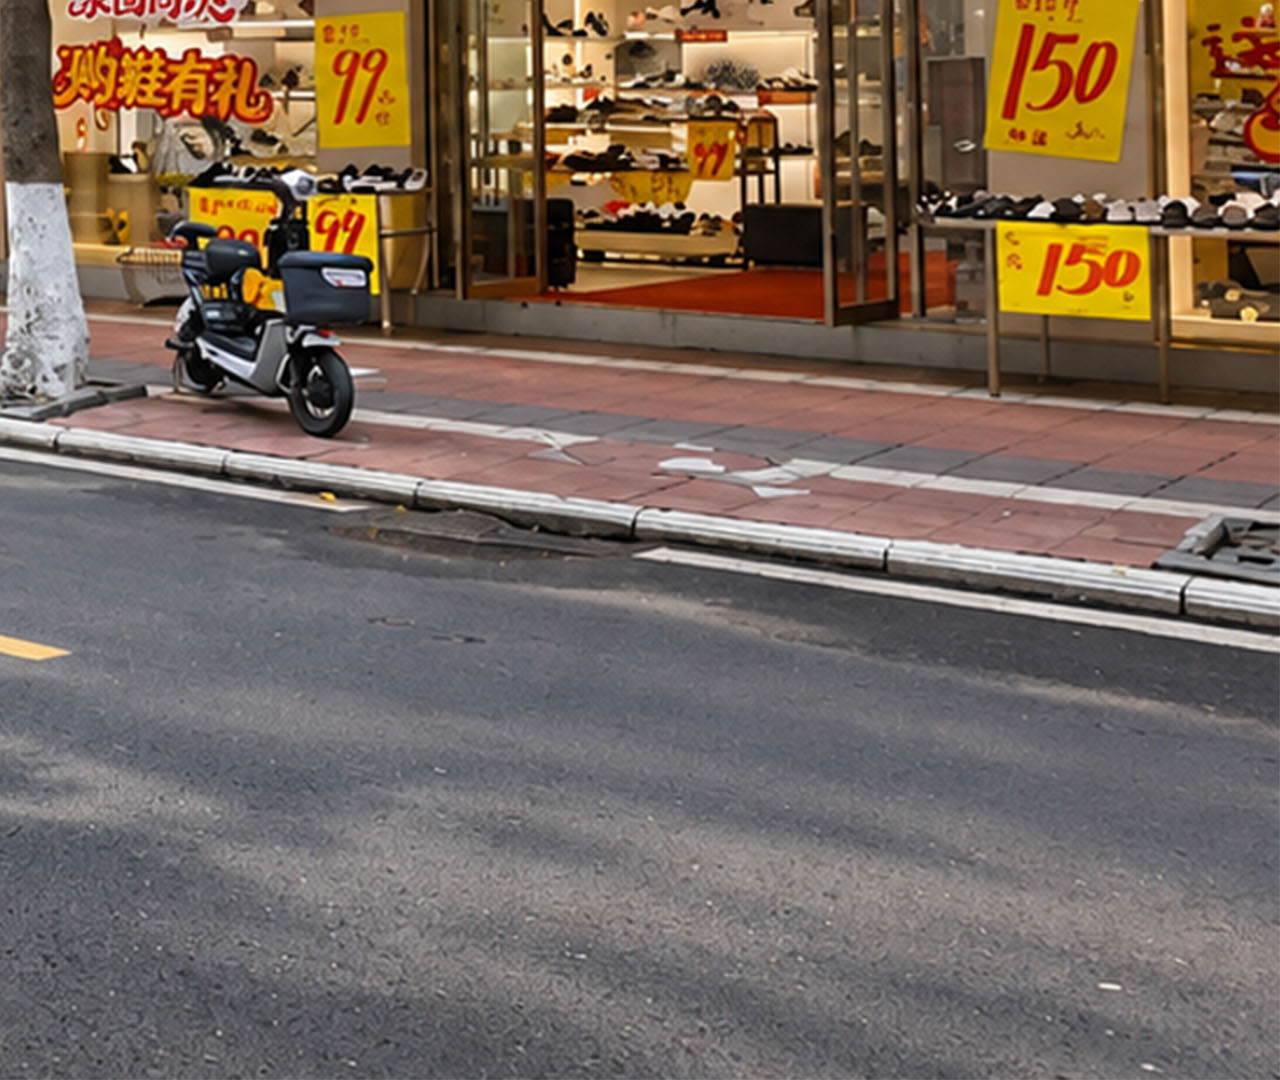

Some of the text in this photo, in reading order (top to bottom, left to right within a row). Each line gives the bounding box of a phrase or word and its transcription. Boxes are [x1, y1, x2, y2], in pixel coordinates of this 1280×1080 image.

[332, 48, 389, 126] 99
[1000, 22, 1120, 121] 150
[1035, 241, 1141, 298] 150
